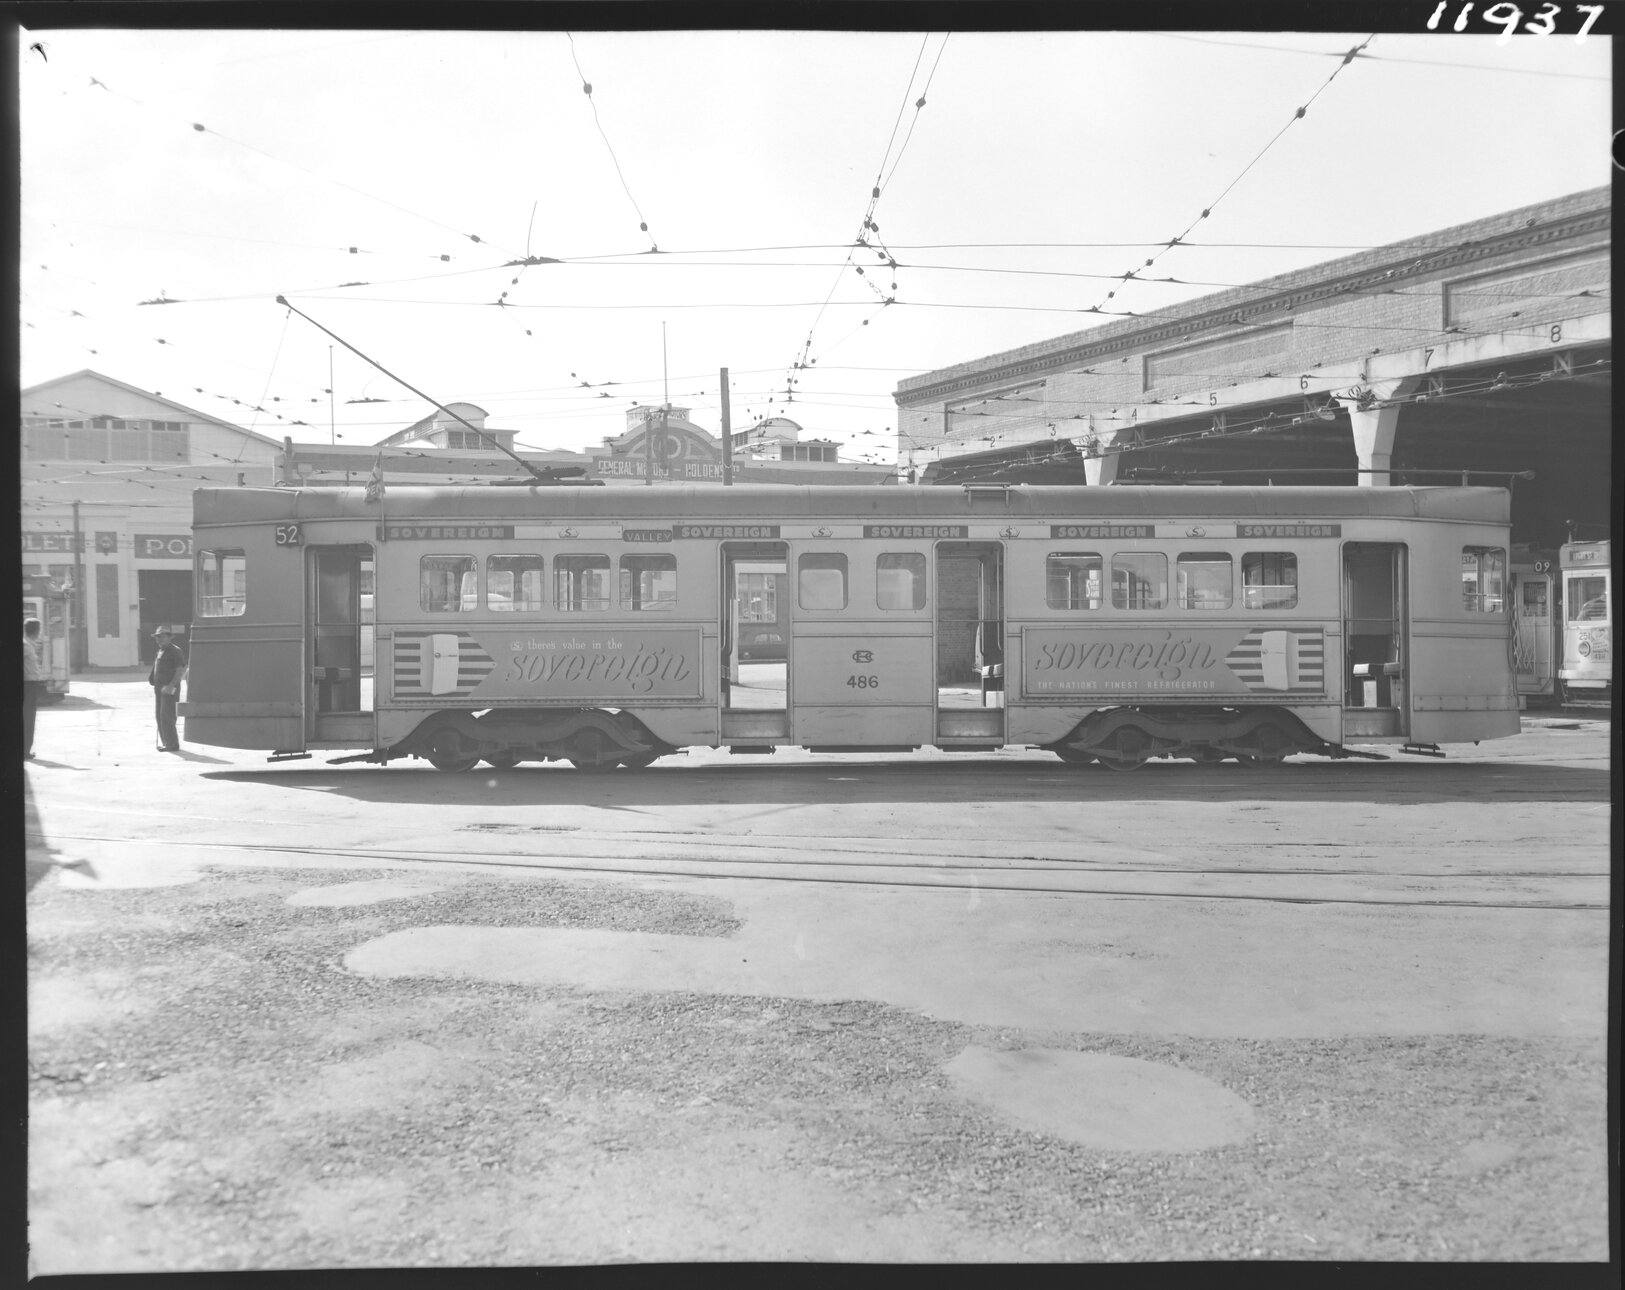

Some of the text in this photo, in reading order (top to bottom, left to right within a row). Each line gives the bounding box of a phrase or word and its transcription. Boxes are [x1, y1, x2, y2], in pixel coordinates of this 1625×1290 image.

[1550, 324, 1562, 343] 8
[1425, 348, 1435, 368] 7
[1300, 374, 1309, 390] 6
[1209, 392, 1218, 407] 5
[1131, 408, 1138, 422] 4
[1050, 423, 1057, 437] 3
[989, 435, 996, 448] 2
[276, 525, 298, 545] 52
[390, 527, 505, 539] SOVEREIGN
[626, 531, 672, 542] VALLEY
[681, 526, 771, 538] SOVEREIGN
[871, 526, 960, 538] SOVEREIGN
[1058, 526, 1147, 537] SOVEREIGN
[1244, 526, 1332, 537] SOVEREIGN
[1534, 561, 1551, 573] 09
[562, 637, 586, 650] value
[592, 639, 602, 650] in
[607, 637, 623, 650] the
[846, 675, 879, 689] 486
[1037, 680, 1053, 689] THE
[1104, 680, 1139, 689] FINEST
[1147, 680, 1216, 689] REFRIGERATOR
